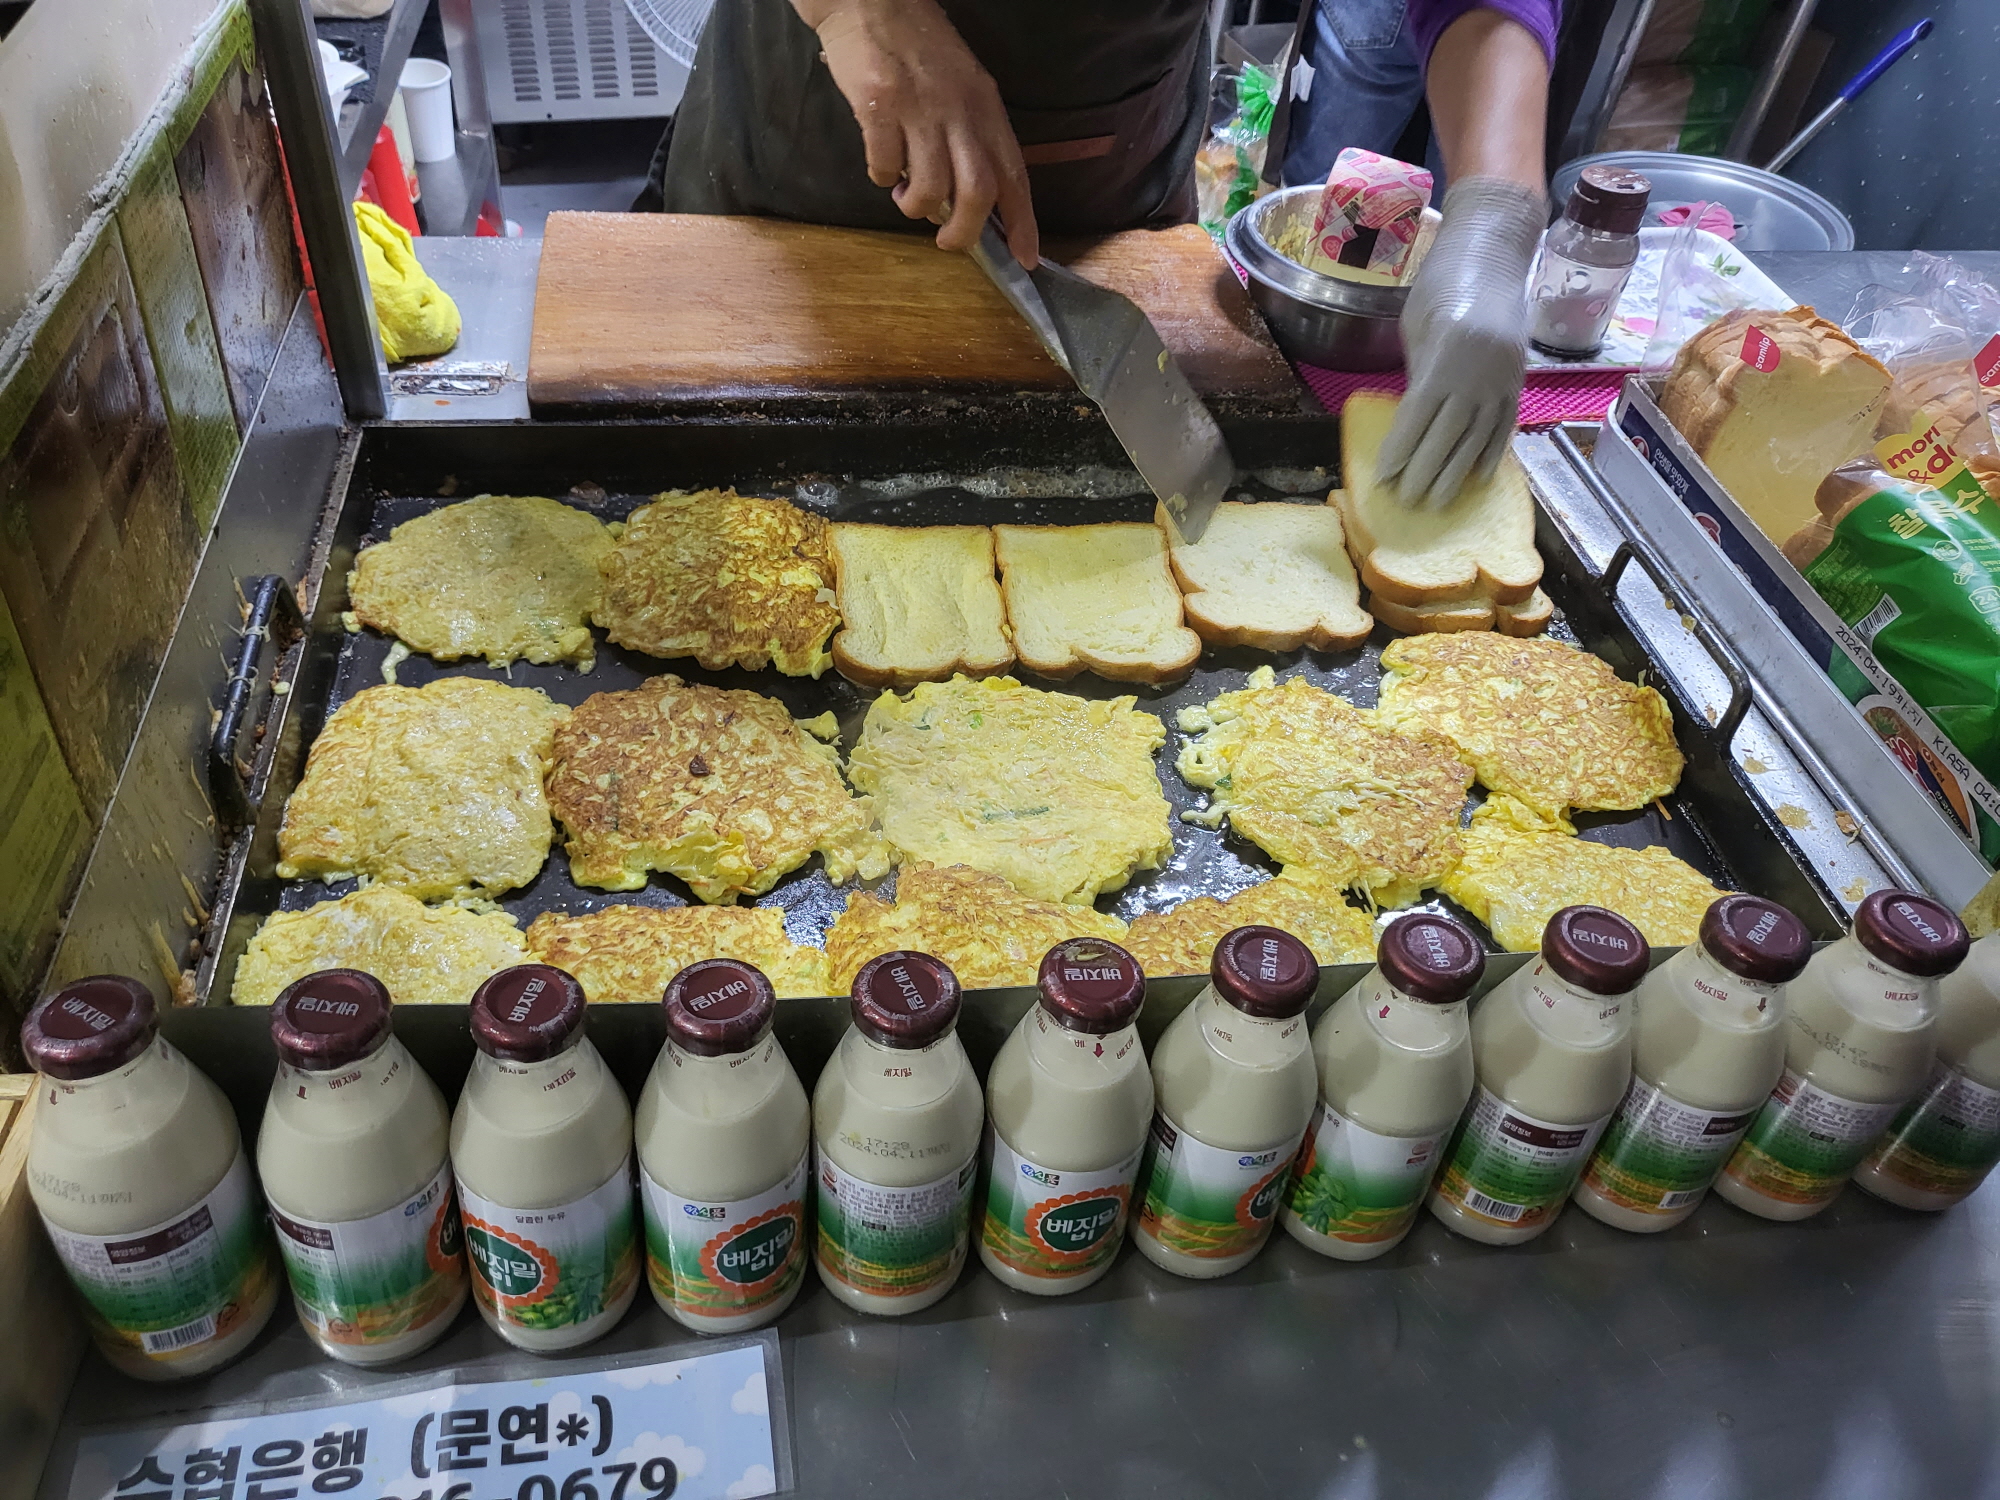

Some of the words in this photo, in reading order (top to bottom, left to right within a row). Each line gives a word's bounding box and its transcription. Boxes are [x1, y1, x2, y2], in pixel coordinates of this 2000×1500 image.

[1755, 337, 1772, 370] samlip
[1572, 928, 1629, 951] 베지밀
[1745, 911, 1782, 945] 베지밀
[1893, 901, 1942, 943] 베지밀
[1259, 938, 1280, 982] 베지밀
[1420, 925, 1451, 968] 베지밀
[890, 965, 926, 1011] 베지밀
[1063, 967, 1123, 981] 베지밀
[61, 996, 116, 1031] 베지밀
[295, 996, 360, 1017] 베지밀
[508, 977, 547, 1023] 베지밀
[689, 980, 749, 1013] 베지밀
[866, 1137, 910, 1149] 17:28
[468, 1234, 537, 1279] 베지밀
[723, 1222, 794, 1268] 베지밀
